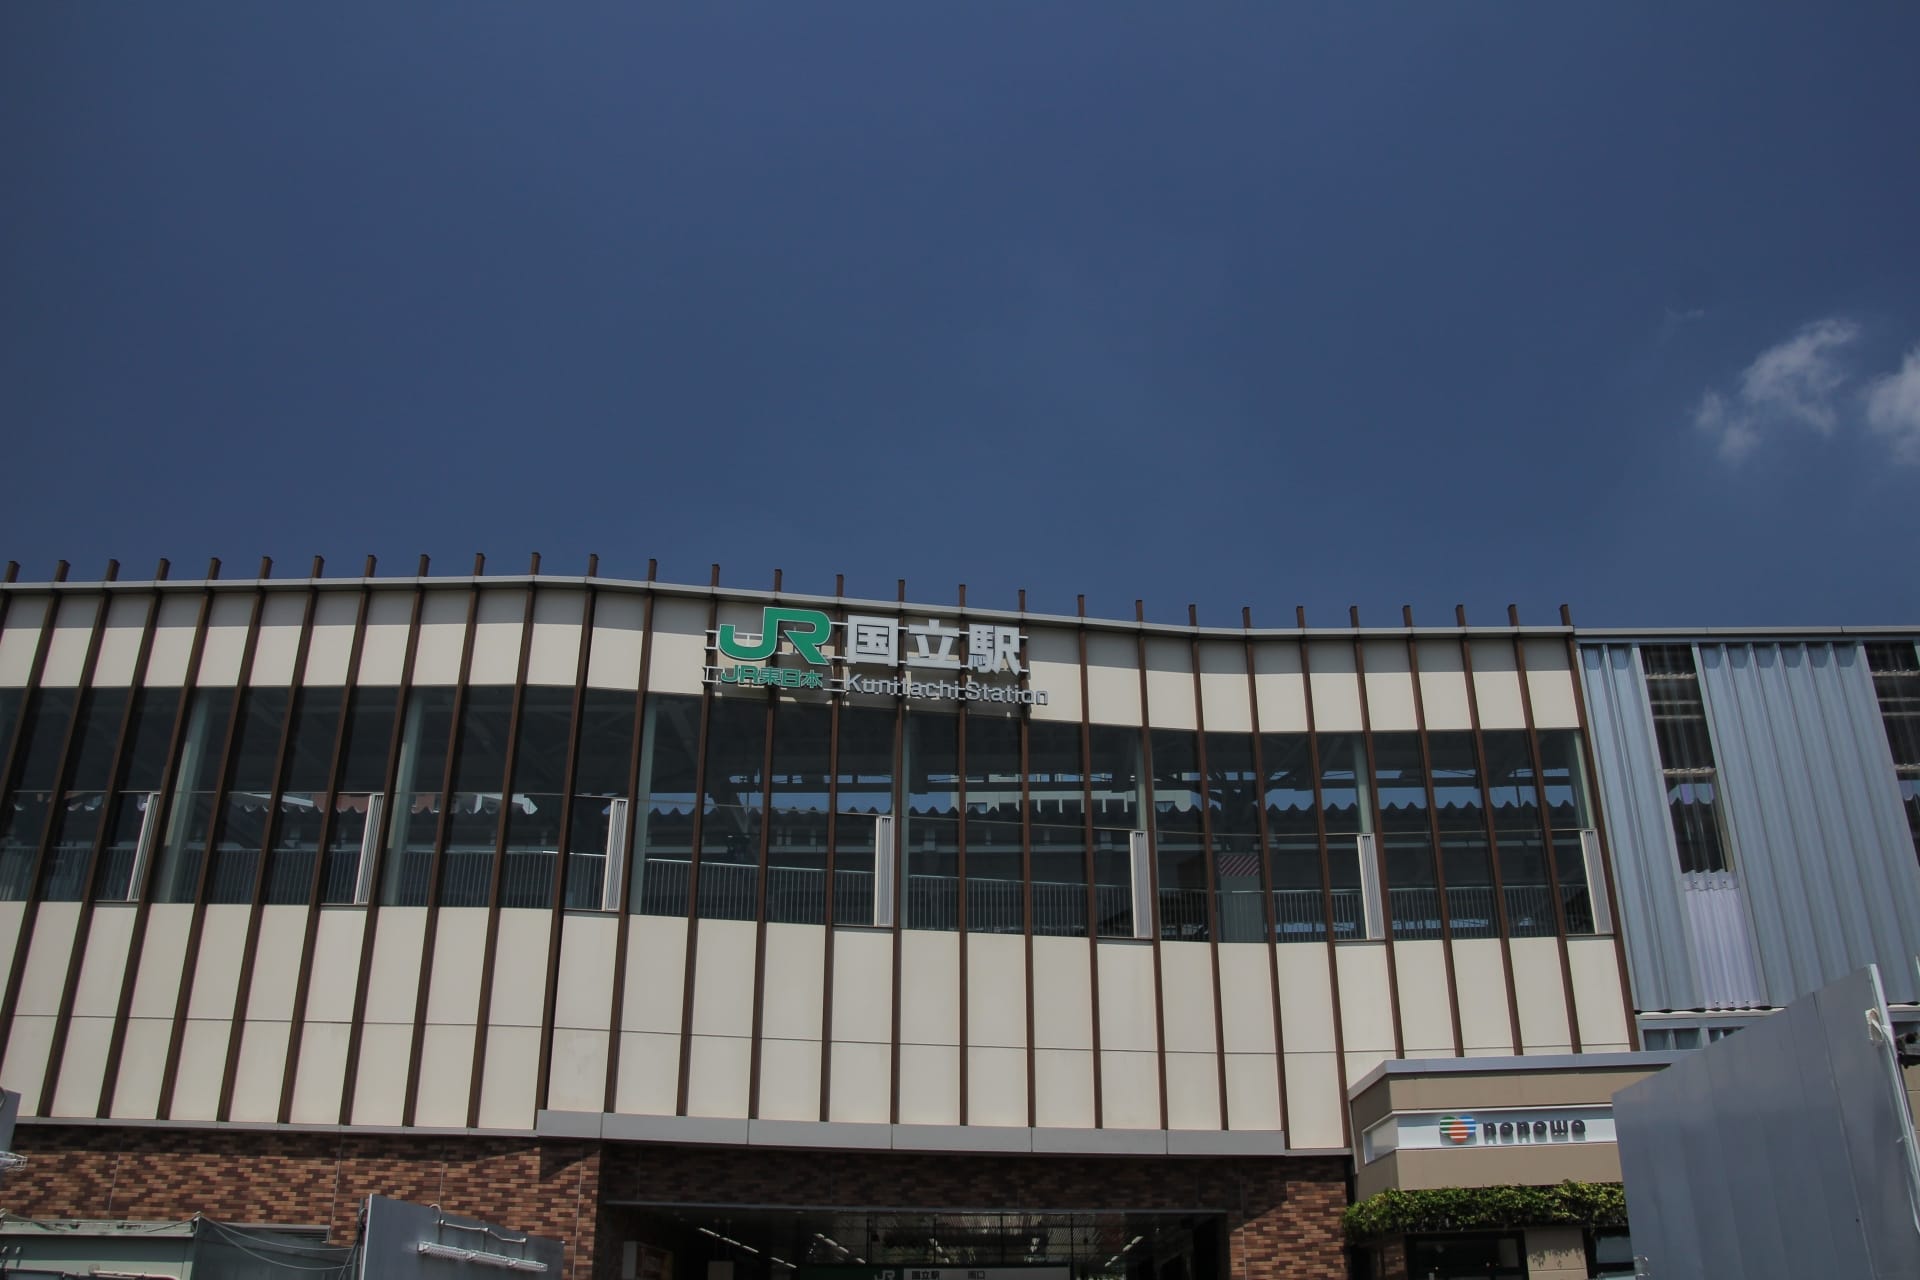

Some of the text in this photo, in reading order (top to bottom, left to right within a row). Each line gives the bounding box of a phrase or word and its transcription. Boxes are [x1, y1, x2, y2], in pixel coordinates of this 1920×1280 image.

[718, 606, 831, 666] JR
[847, 615, 1021, 675] 国立駅
[721, 666, 823, 689] JR東日本
[846, 673, 1049, 707] Kunitachi Station
[1483, 1119, 1586, 1138] nonowa
